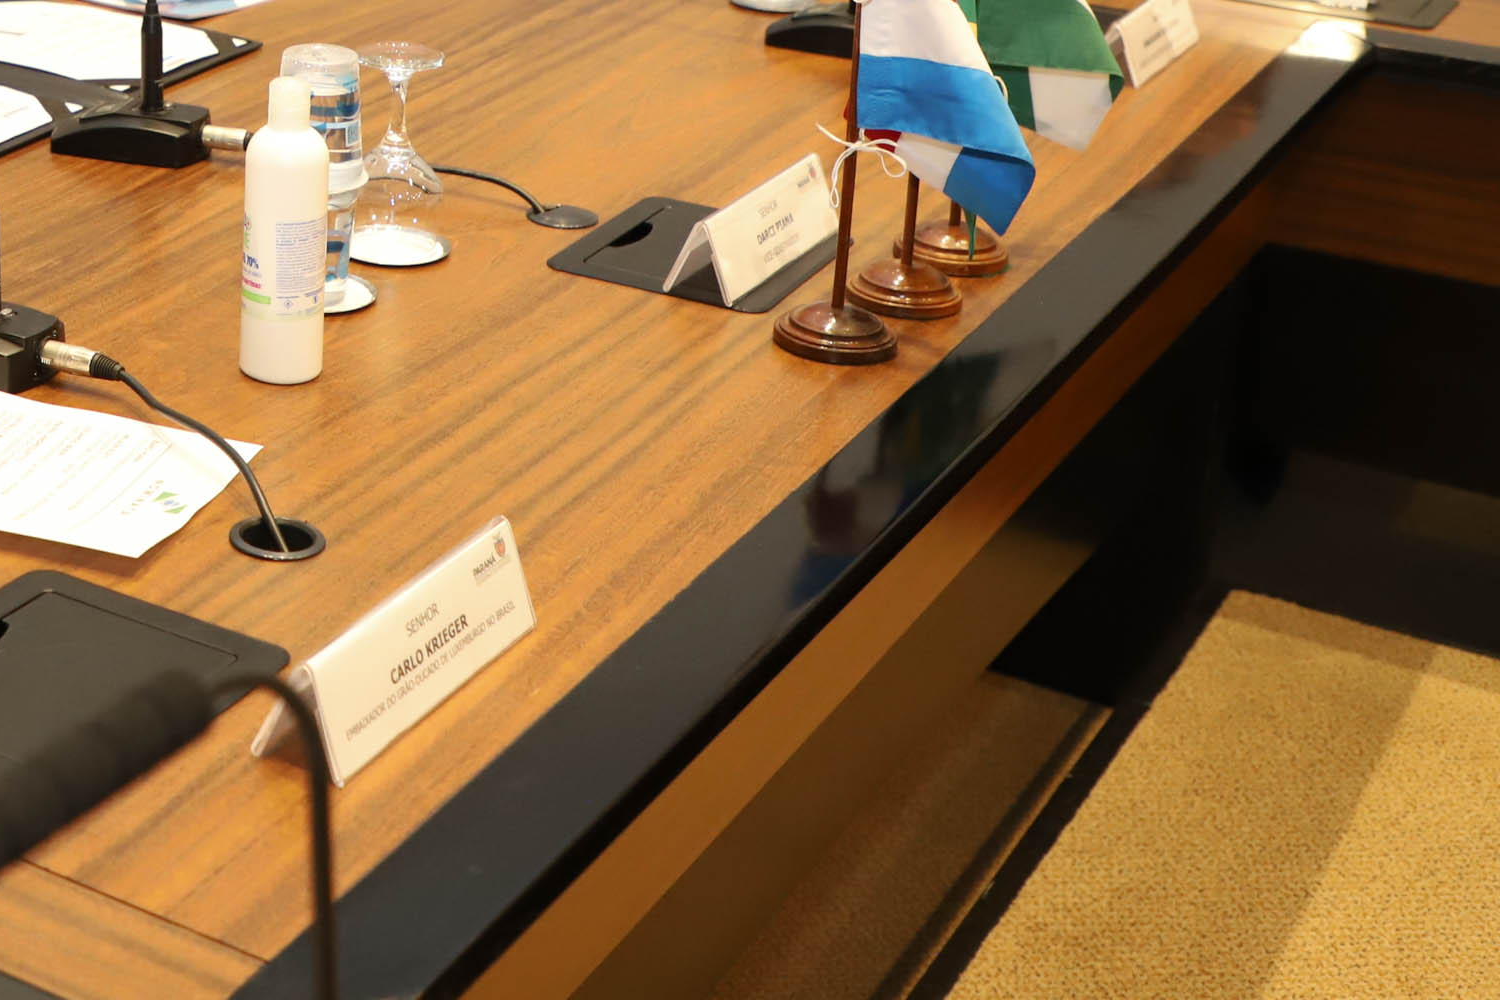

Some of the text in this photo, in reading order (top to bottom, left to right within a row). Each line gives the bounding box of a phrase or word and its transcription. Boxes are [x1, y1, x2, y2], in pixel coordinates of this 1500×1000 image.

[756, 225, 775, 245] DARCI
[246, 255, 259, 269] 70%
[405, 602, 440, 638] SENHOR
[390, 614, 469, 684] CARLO KRIEGER
[345, 699, 387, 742] EMBAIXADOR
[496, 600, 517, 620] BRASIL
